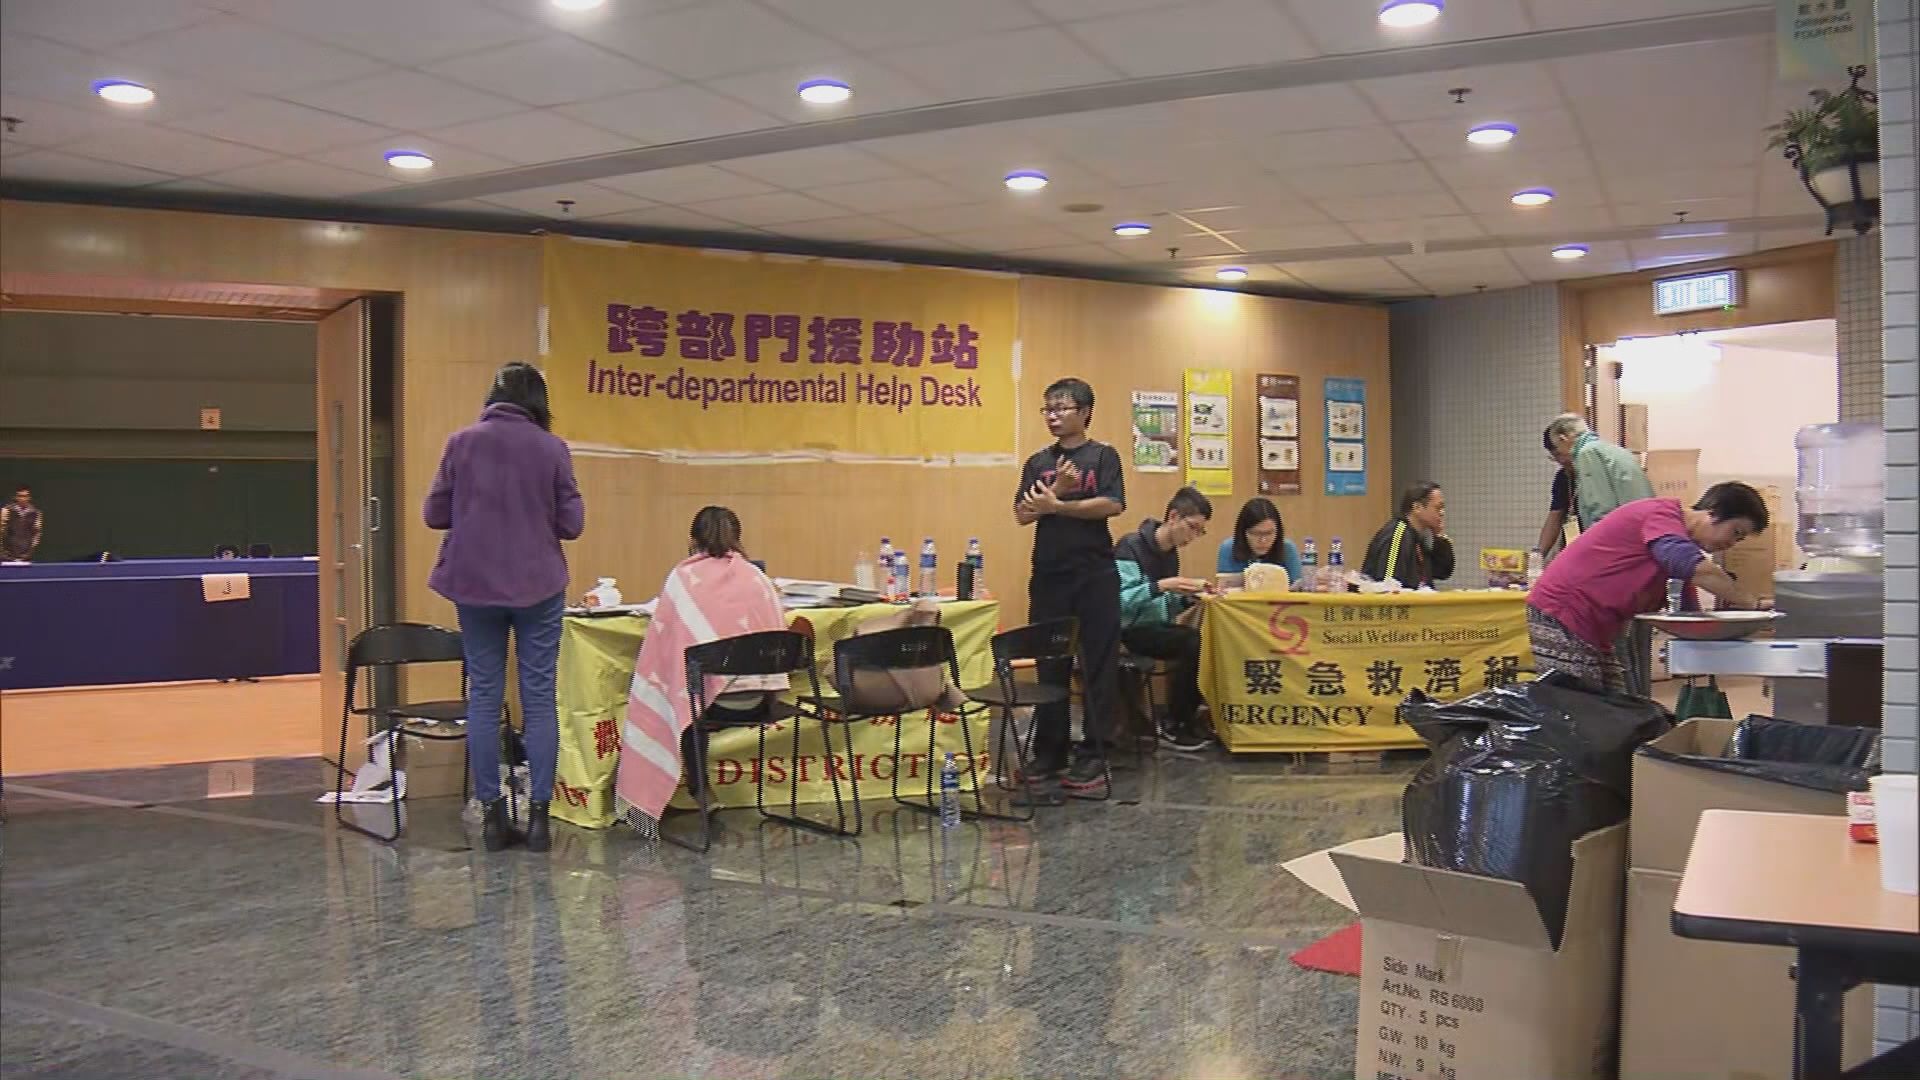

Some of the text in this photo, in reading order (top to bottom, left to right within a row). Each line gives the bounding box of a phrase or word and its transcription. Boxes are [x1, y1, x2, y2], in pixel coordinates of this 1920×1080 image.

[1659, 282, 1693, 309] EXIT
[606, 303, 980, 369] 跨部門援助站
[587, 359, 983, 414] Inter-departmental Help Desk
[1322, 626, 1500, 646] Social Welfare Department
[714, 753, 928, 785] DISTRICT
[1383, 955, 1445, 983] Side Mark
[1419, 1009, 1427, 1024] 5
[1436, 1013, 1460, 1029] pcs
[1414, 1034, 1429, 1050] 10
[1439, 1038, 1456, 1059] kg
[1415, 1058, 1425, 1072] 9
[1439, 1062, 1456, 1080] kg
